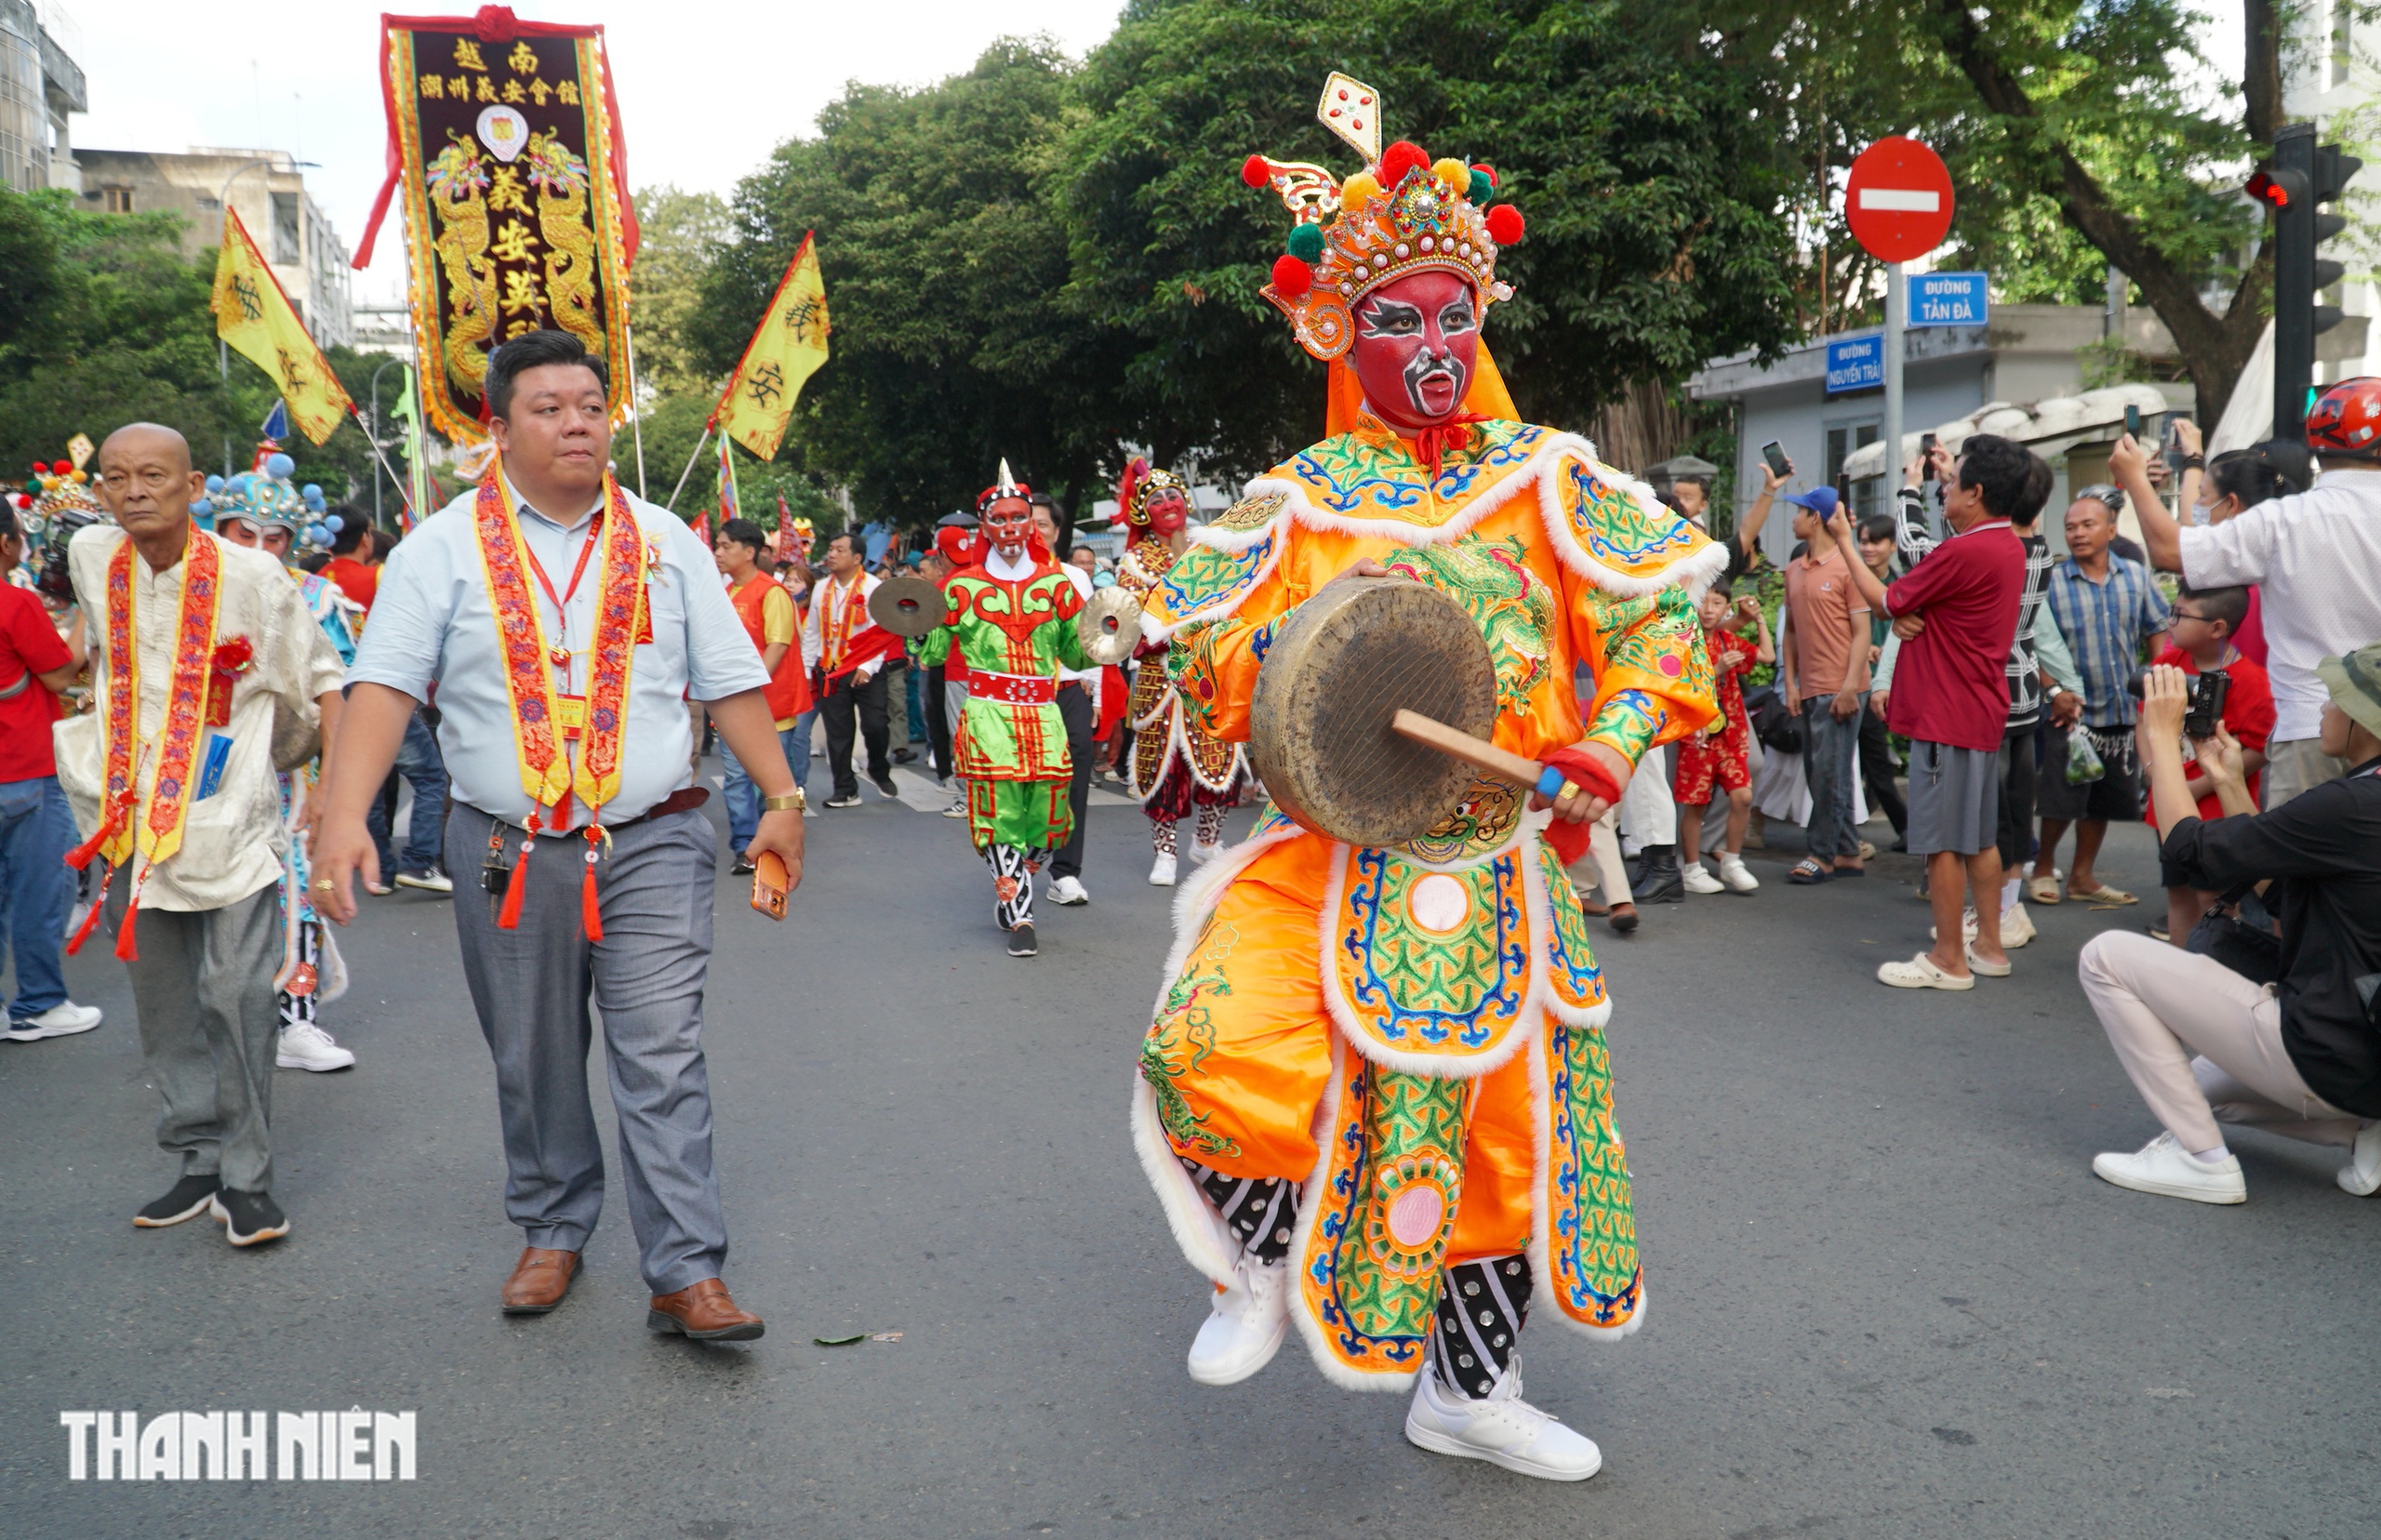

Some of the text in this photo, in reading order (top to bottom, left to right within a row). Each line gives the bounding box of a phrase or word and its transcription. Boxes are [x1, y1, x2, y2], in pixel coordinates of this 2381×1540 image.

[1924, 280, 1971, 295] ĐƯỜNG
[1922, 298, 1973, 320] TẢN ĐÀ
[1838, 342, 1872, 361] ĐƯỜNG
